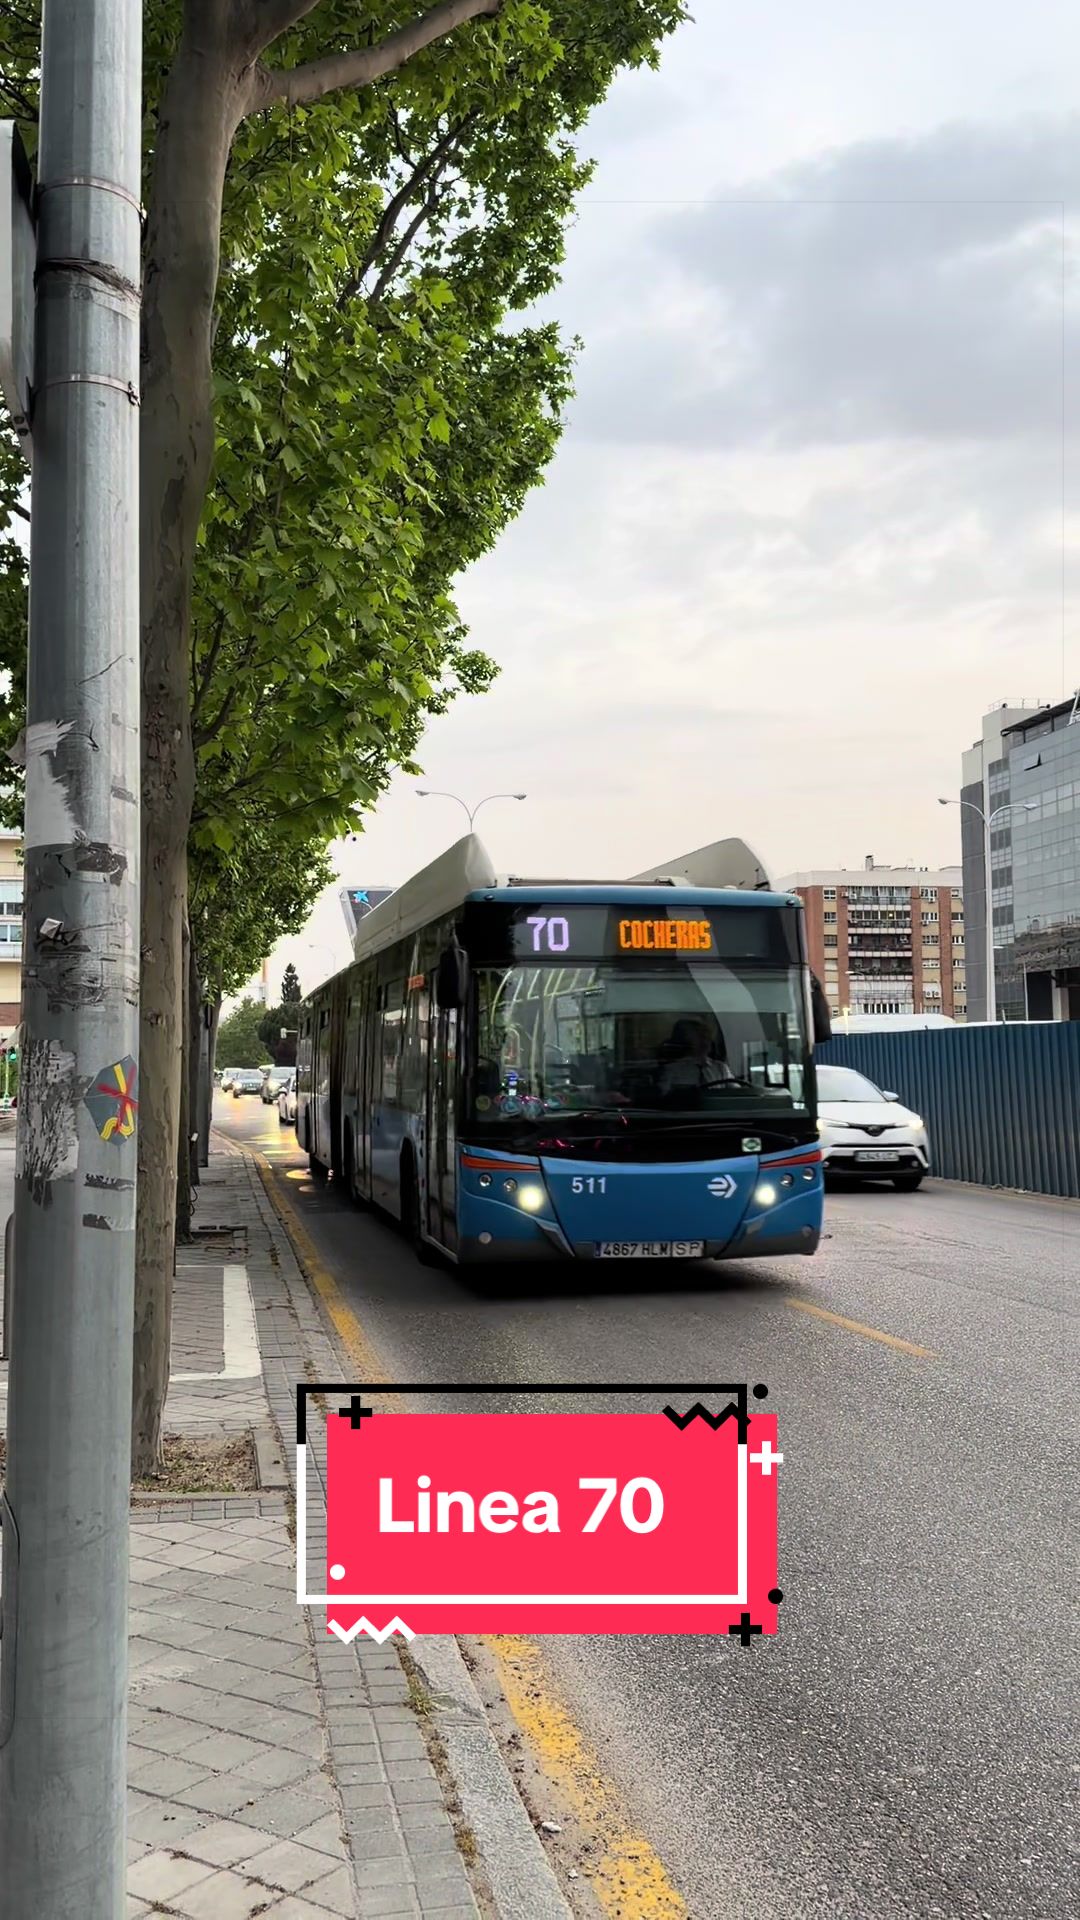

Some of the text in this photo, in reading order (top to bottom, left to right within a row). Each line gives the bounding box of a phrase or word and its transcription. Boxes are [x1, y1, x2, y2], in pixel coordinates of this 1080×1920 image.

[527, 916, 712, 951] 70 COCHERAS
[572, 1177, 607, 1194] 511
[603, 1242, 638, 1256] 4867
